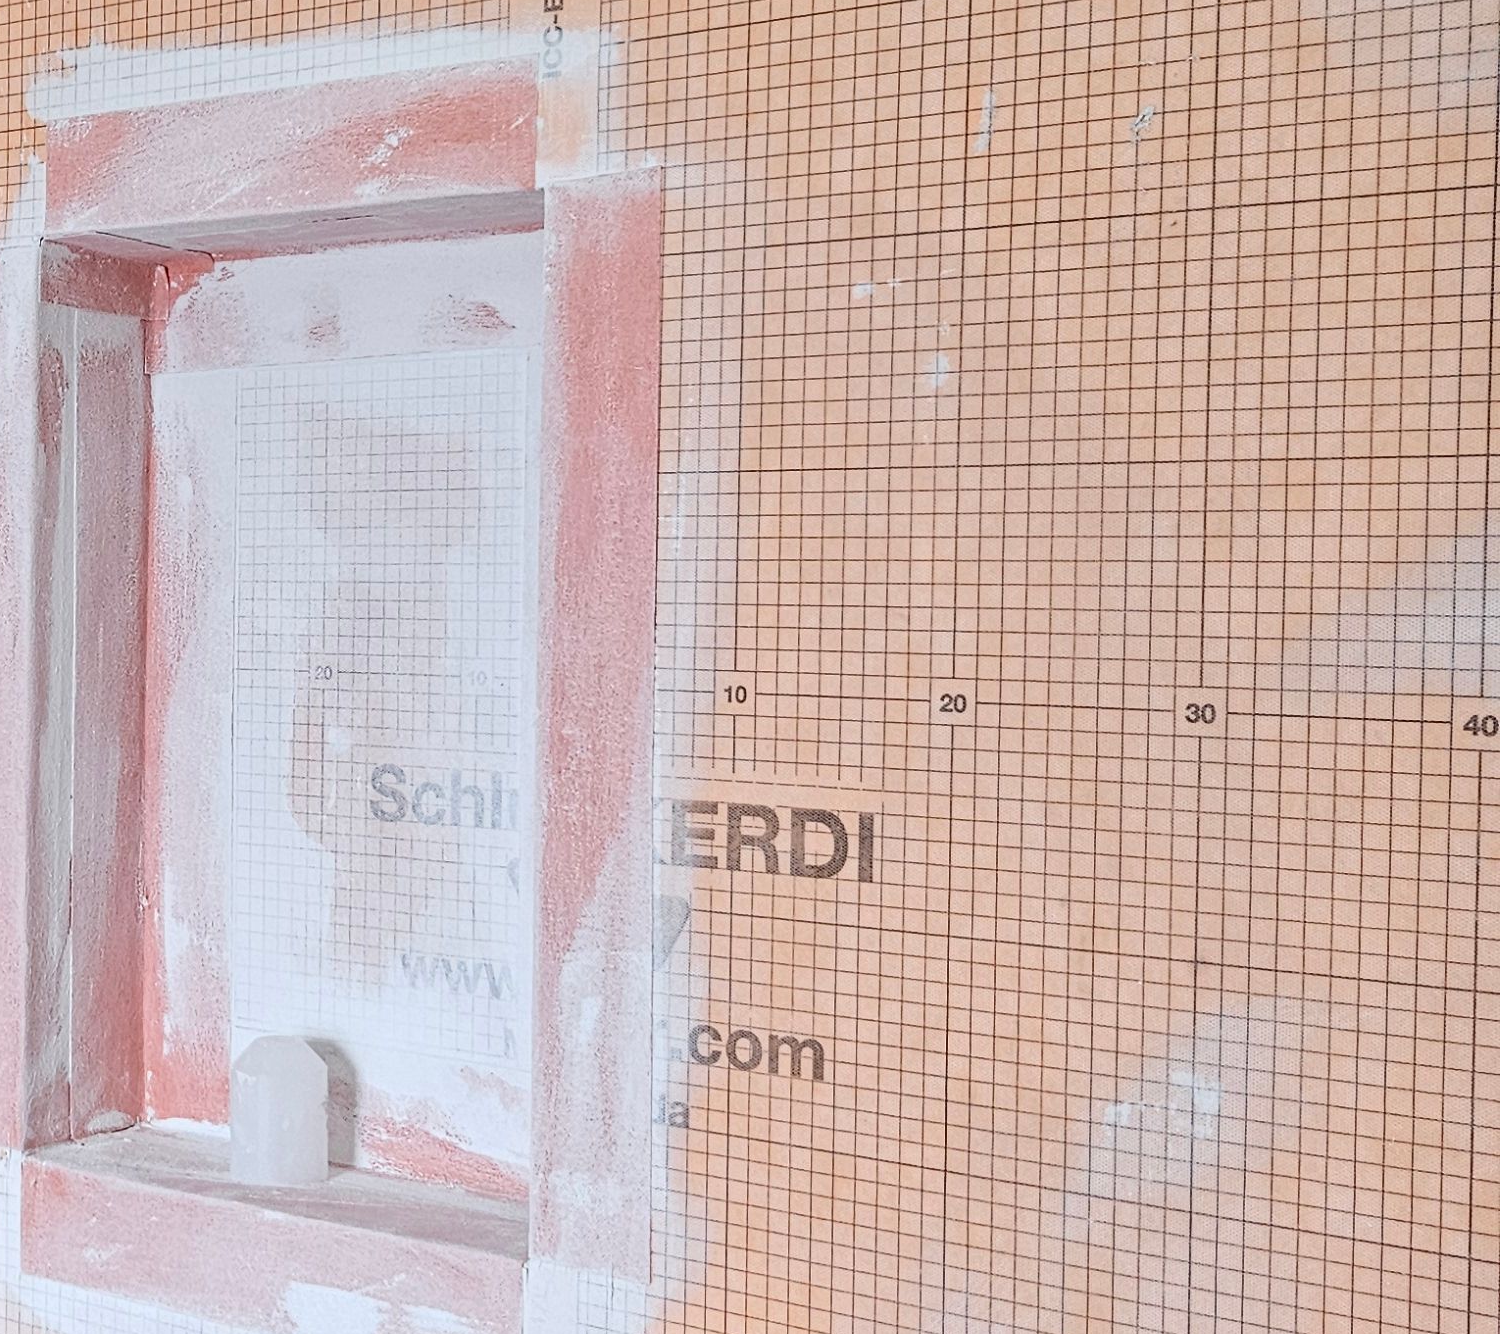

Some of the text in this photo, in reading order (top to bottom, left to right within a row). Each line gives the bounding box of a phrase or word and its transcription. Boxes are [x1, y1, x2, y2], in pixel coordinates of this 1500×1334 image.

[315, 666, 332, 680] 20
[724, 685, 1499, 736] 10 20 30 40
[668, 800, 874, 882] ERDI
[666, 1023, 824, 1081] .com
